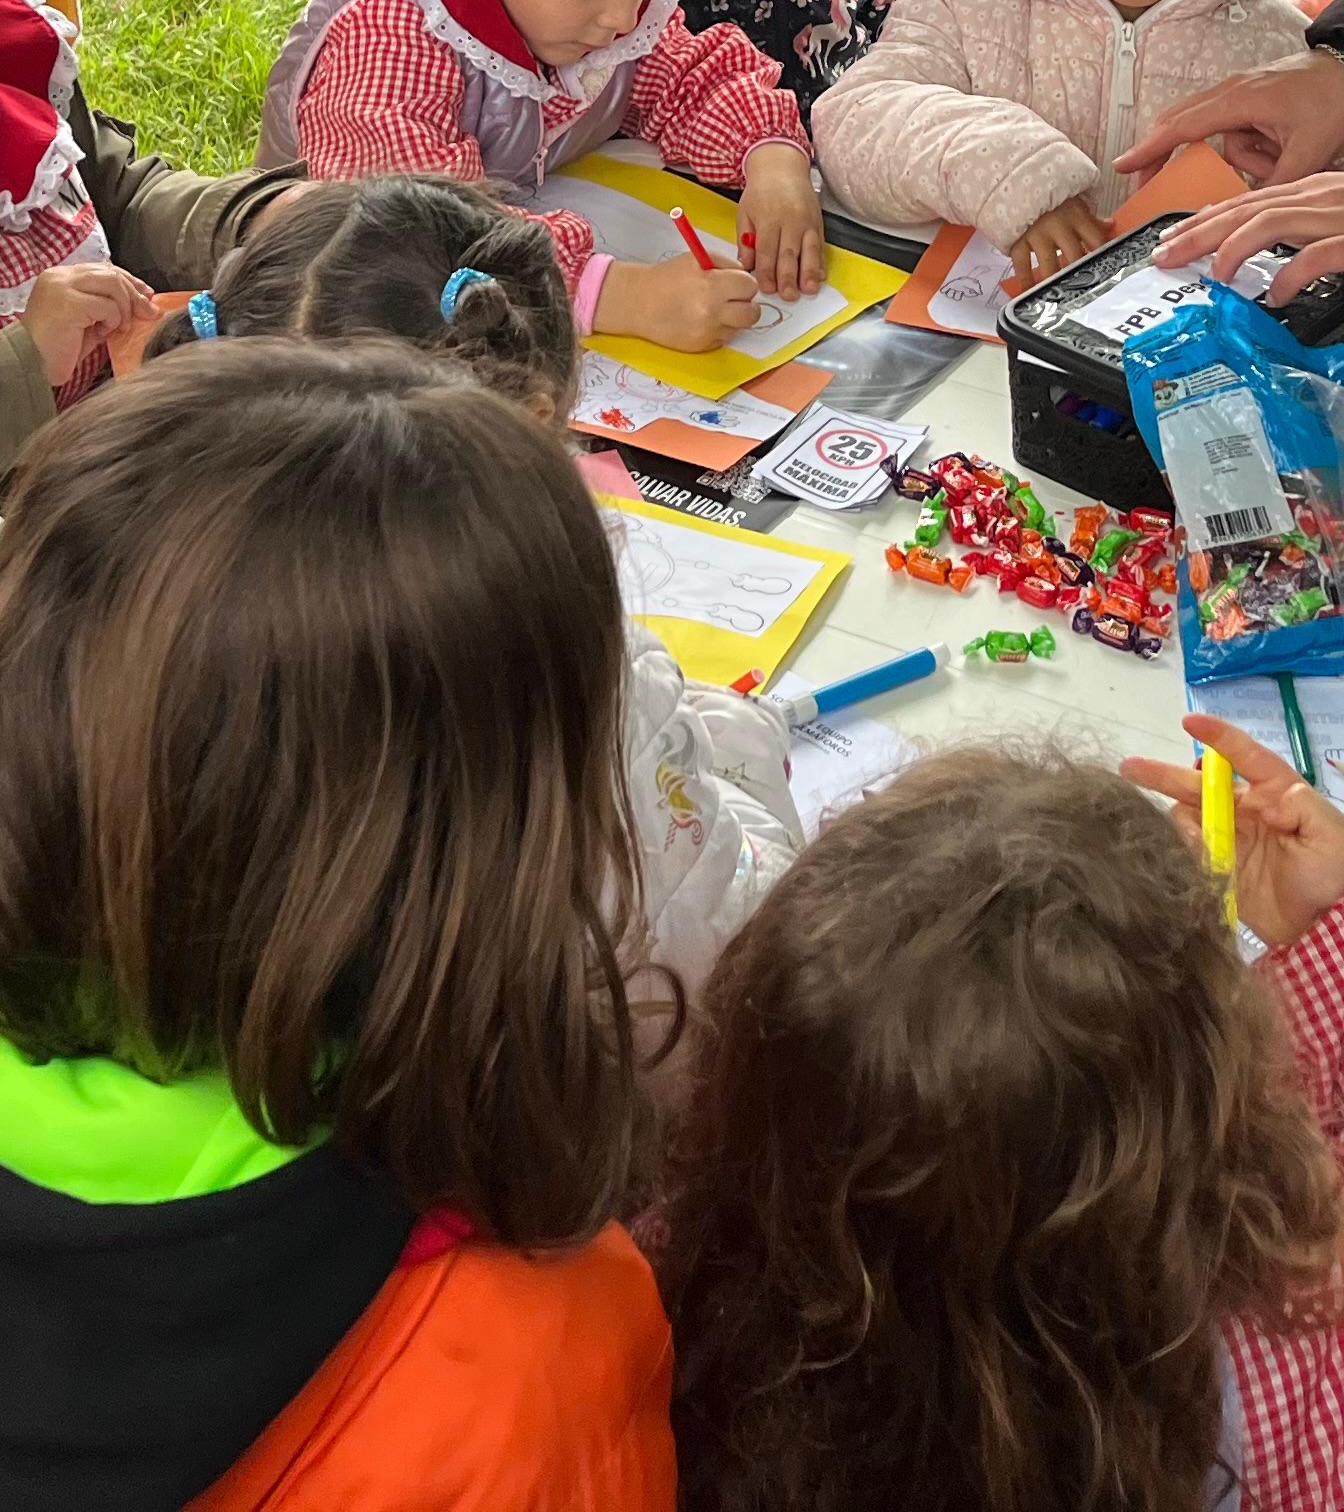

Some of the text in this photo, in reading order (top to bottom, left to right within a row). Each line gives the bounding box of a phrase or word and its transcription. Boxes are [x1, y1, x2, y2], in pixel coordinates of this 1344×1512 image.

[1115, 307, 1162, 335] FPB
[828, 435, 877, 461] 25
[828, 453, 856, 466] KPH
[791, 458, 858, 489] VELOCIDAD
